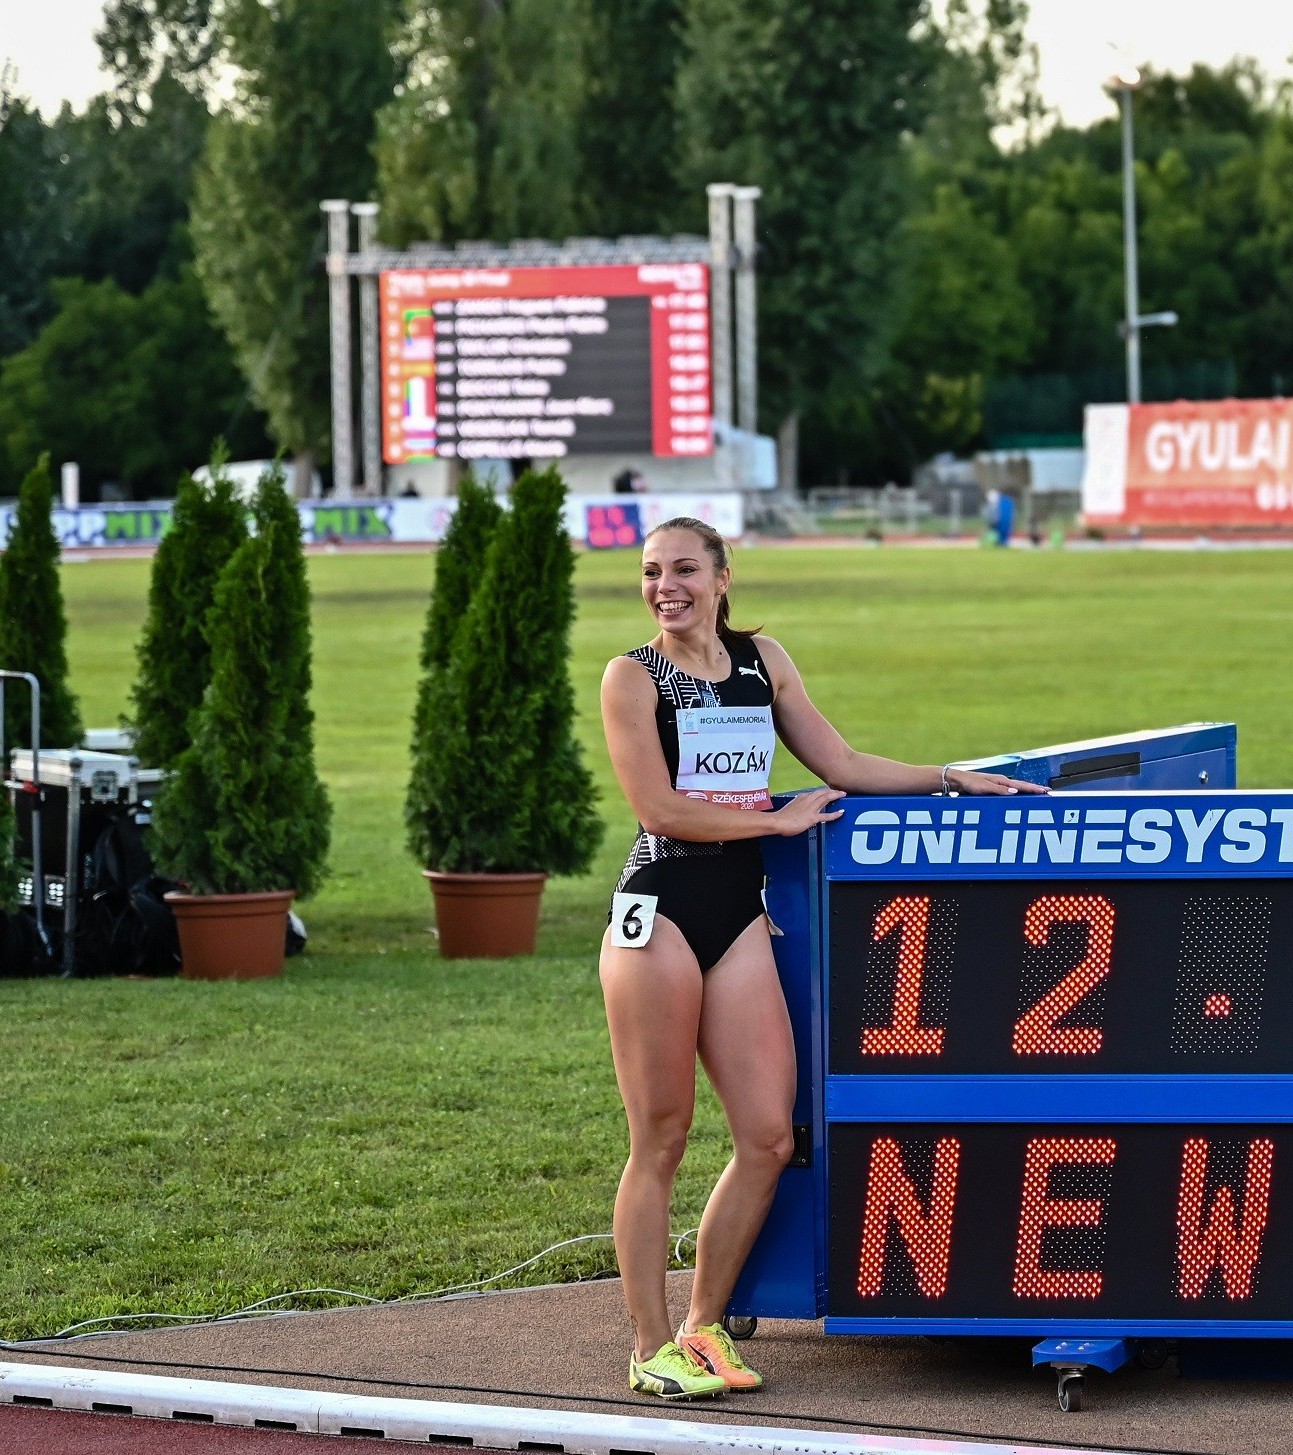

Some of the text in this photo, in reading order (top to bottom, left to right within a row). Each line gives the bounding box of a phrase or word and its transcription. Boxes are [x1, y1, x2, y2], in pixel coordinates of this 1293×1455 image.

[1146, 419, 1288, 472] GYULAI
[695, 745, 769, 774] KOZÁK
[622, 902, 643, 940] 6
[857, 1136, 1275, 1299] NEW
